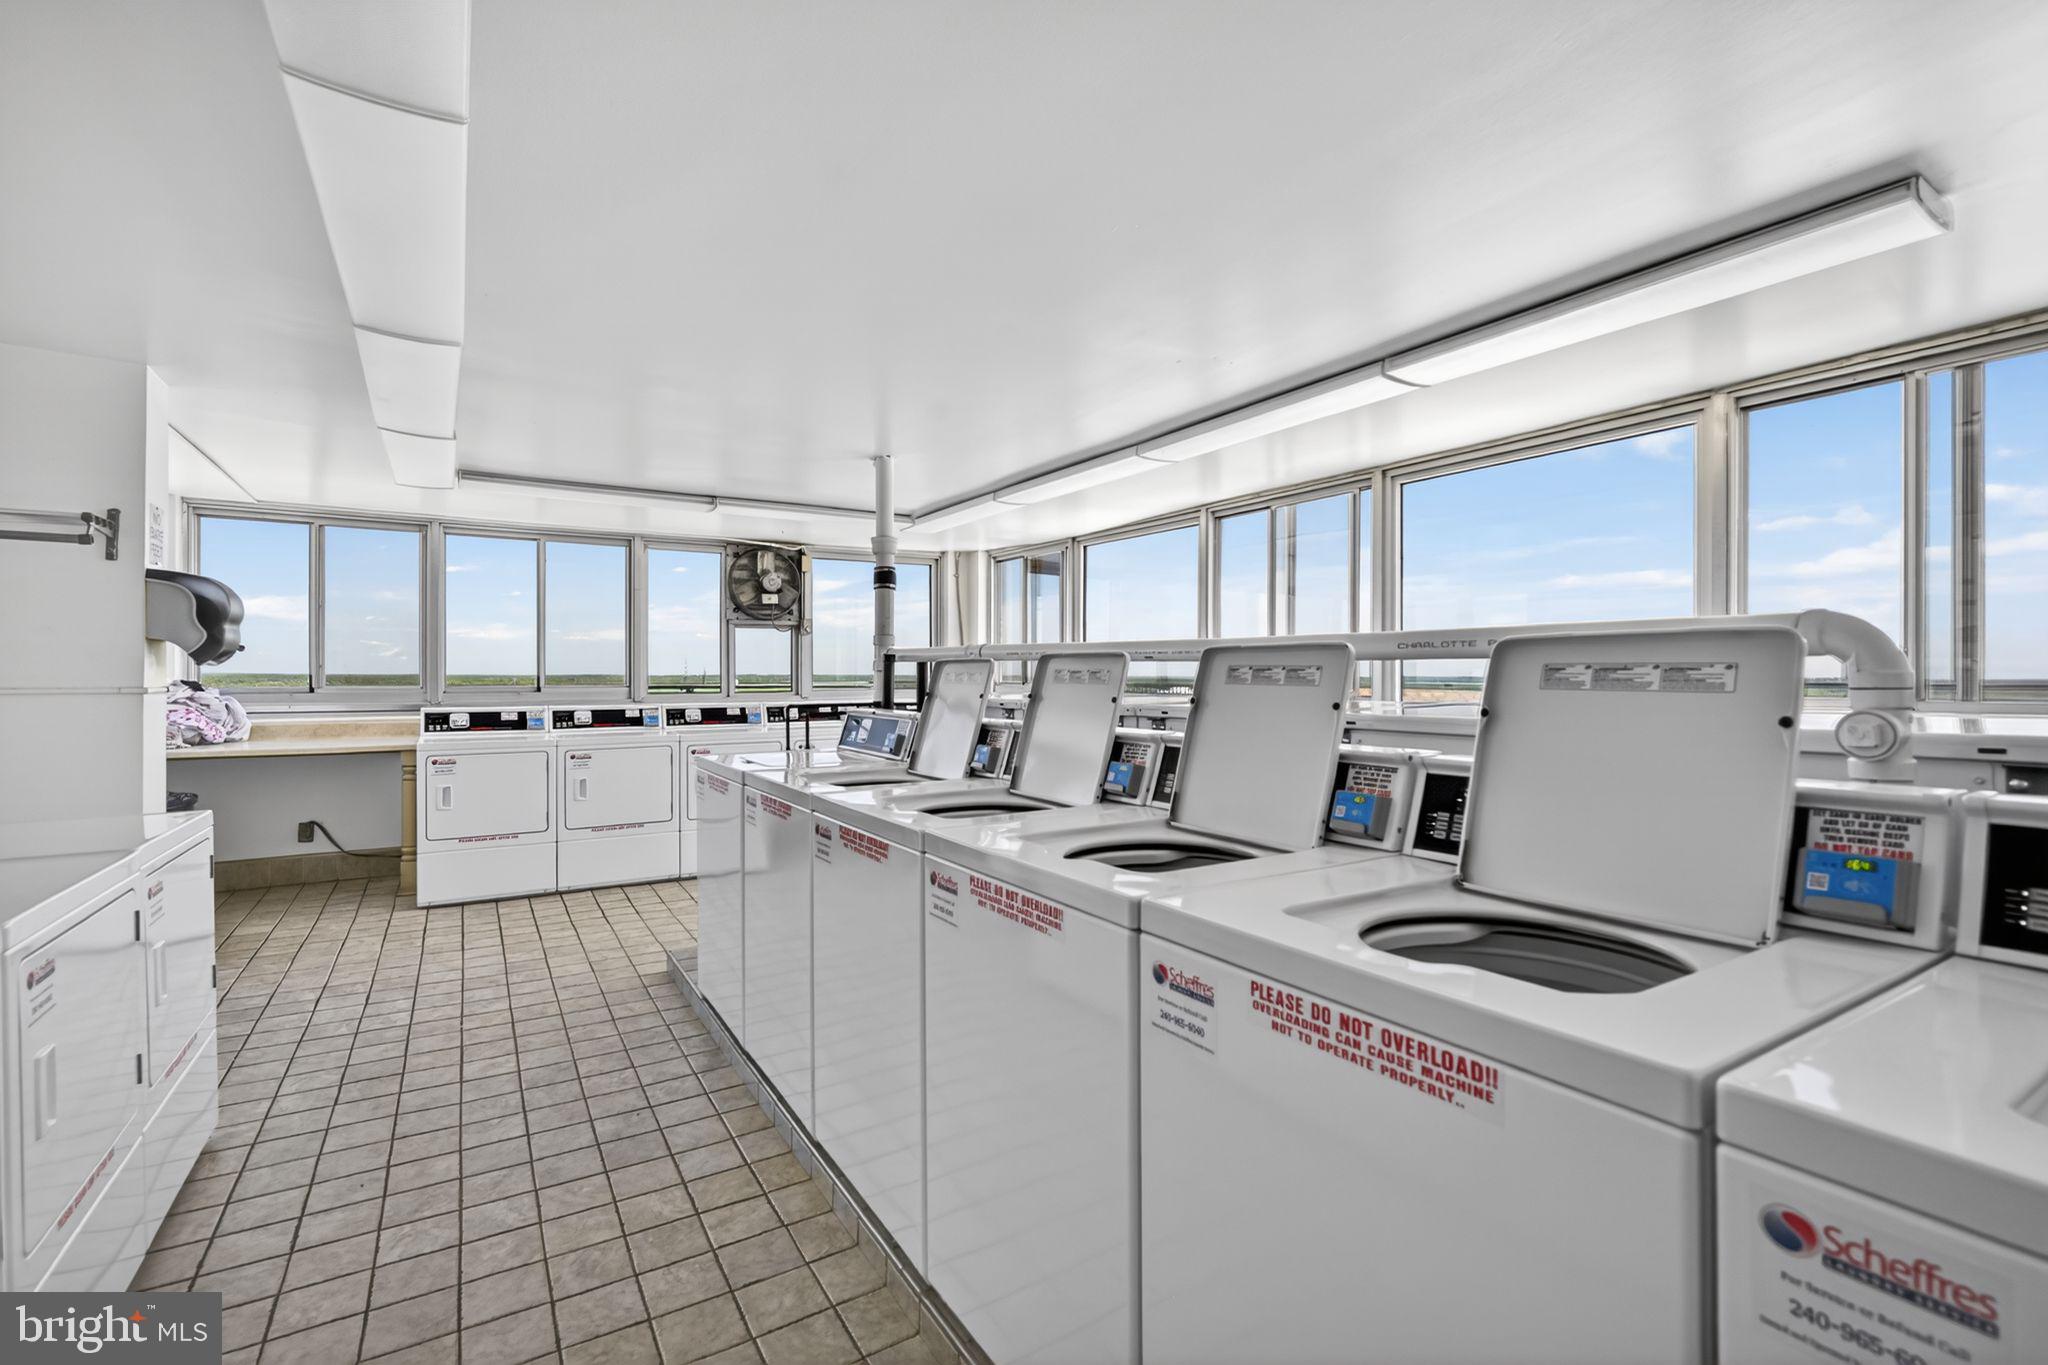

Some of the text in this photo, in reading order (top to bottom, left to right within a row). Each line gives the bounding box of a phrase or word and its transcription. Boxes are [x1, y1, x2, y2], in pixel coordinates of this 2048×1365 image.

[1397, 639, 1477, 650] CHARLOTTE
[1250, 980, 1303, 1016] PLEASE
[1311, 1002, 1331, 1025] DO
[1339, 1012, 1373, 1041] NOT
[1381, 1027, 1498, 1090] OVERLOAD!!
[1252, 999, 1330, 1039] OVERLOADING
[1335, 1031, 1362, 1051] CAN
[1367, 1044, 1414, 1072] CAUSE
[1421, 1064, 1495, 1105] MACHINE
[1271, 1019, 1293, 1037] NOT
[1297, 1030, 1312, 1046] TO
[1317, 1039, 1374, 1072] OPERATE
[1822, 1225, 1999, 1322] Scheffres
